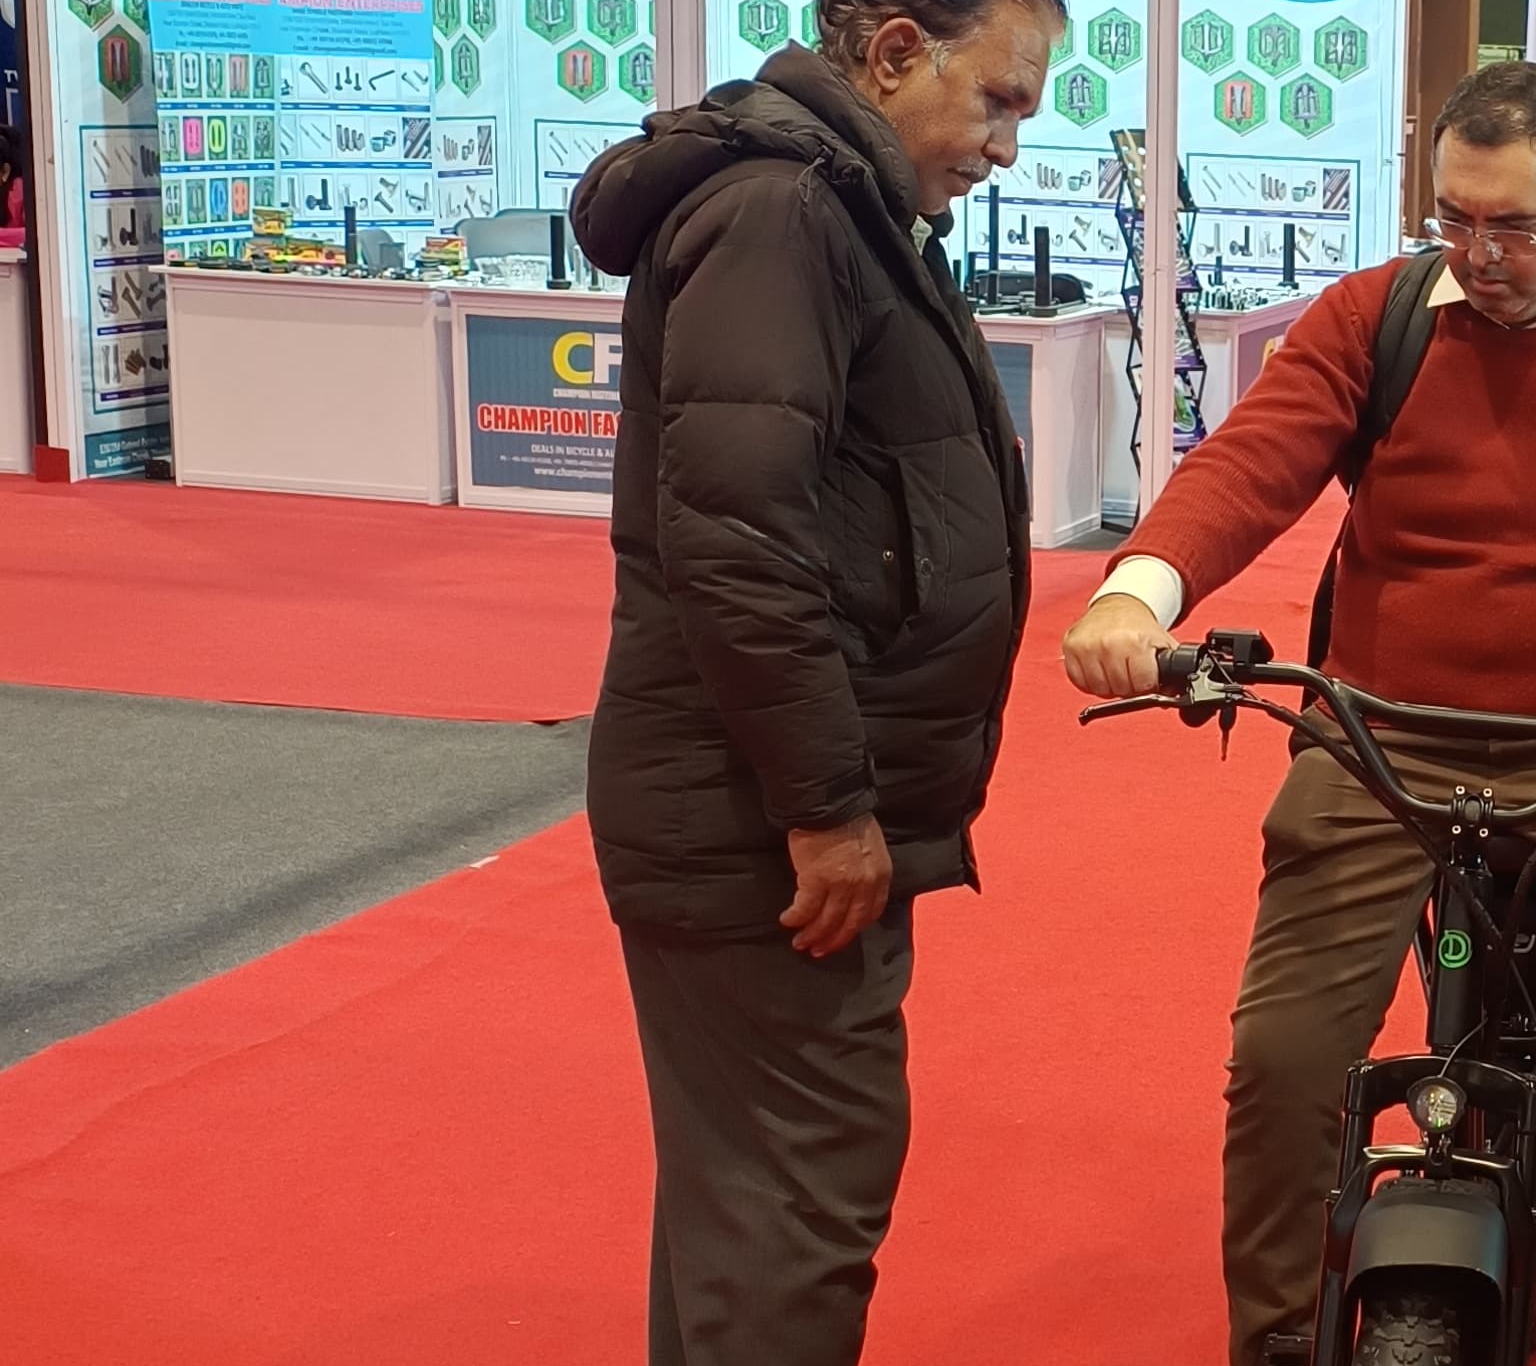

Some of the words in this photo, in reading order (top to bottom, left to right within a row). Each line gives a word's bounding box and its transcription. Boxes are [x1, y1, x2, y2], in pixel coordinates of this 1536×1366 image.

[553, 331, 622, 384] CF
[479, 405, 588, 435] CHAMPION
[593, 412, 620, 437] FA
[531, 443, 554, 454] DEALS
[556, 445, 565, 455] IN
[566, 446, 595, 456] BICYCLE
